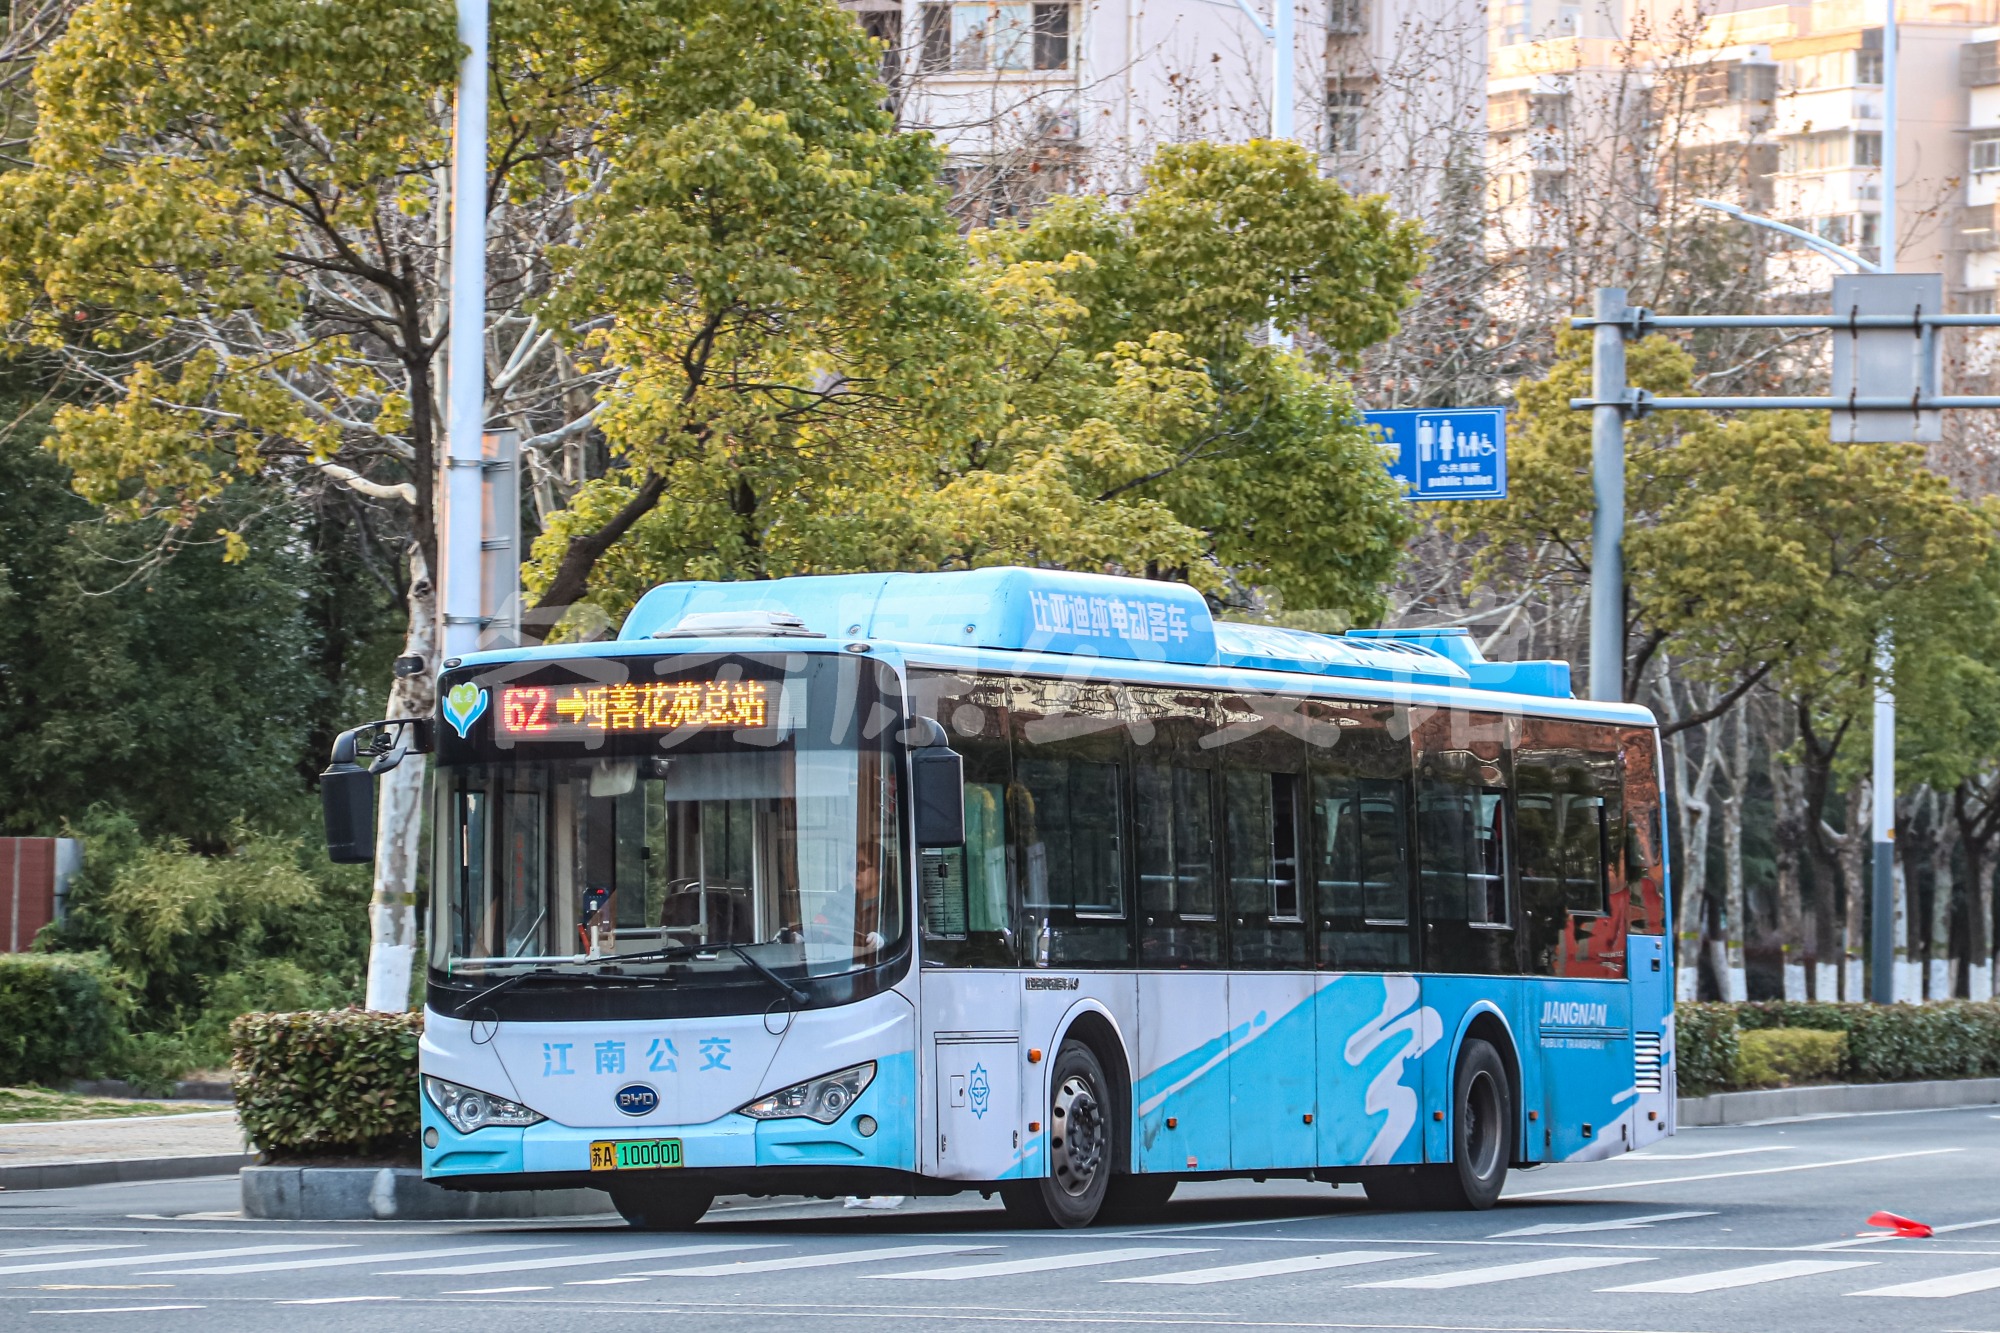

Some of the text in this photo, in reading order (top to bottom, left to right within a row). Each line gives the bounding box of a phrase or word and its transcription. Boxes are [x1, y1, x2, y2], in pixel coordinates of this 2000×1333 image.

[1028, 590, 1189, 644] 比亚迪纯电动客车
[503, 687, 548, 733] 62
[1540, 1001, 1608, 1026] JIANGNAN
[542, 1037, 732, 1078] 江南公交
[1540, 1038, 1605, 1050] PUBLIC TRANSPORT
[619, 1092, 654, 1107] BYD
